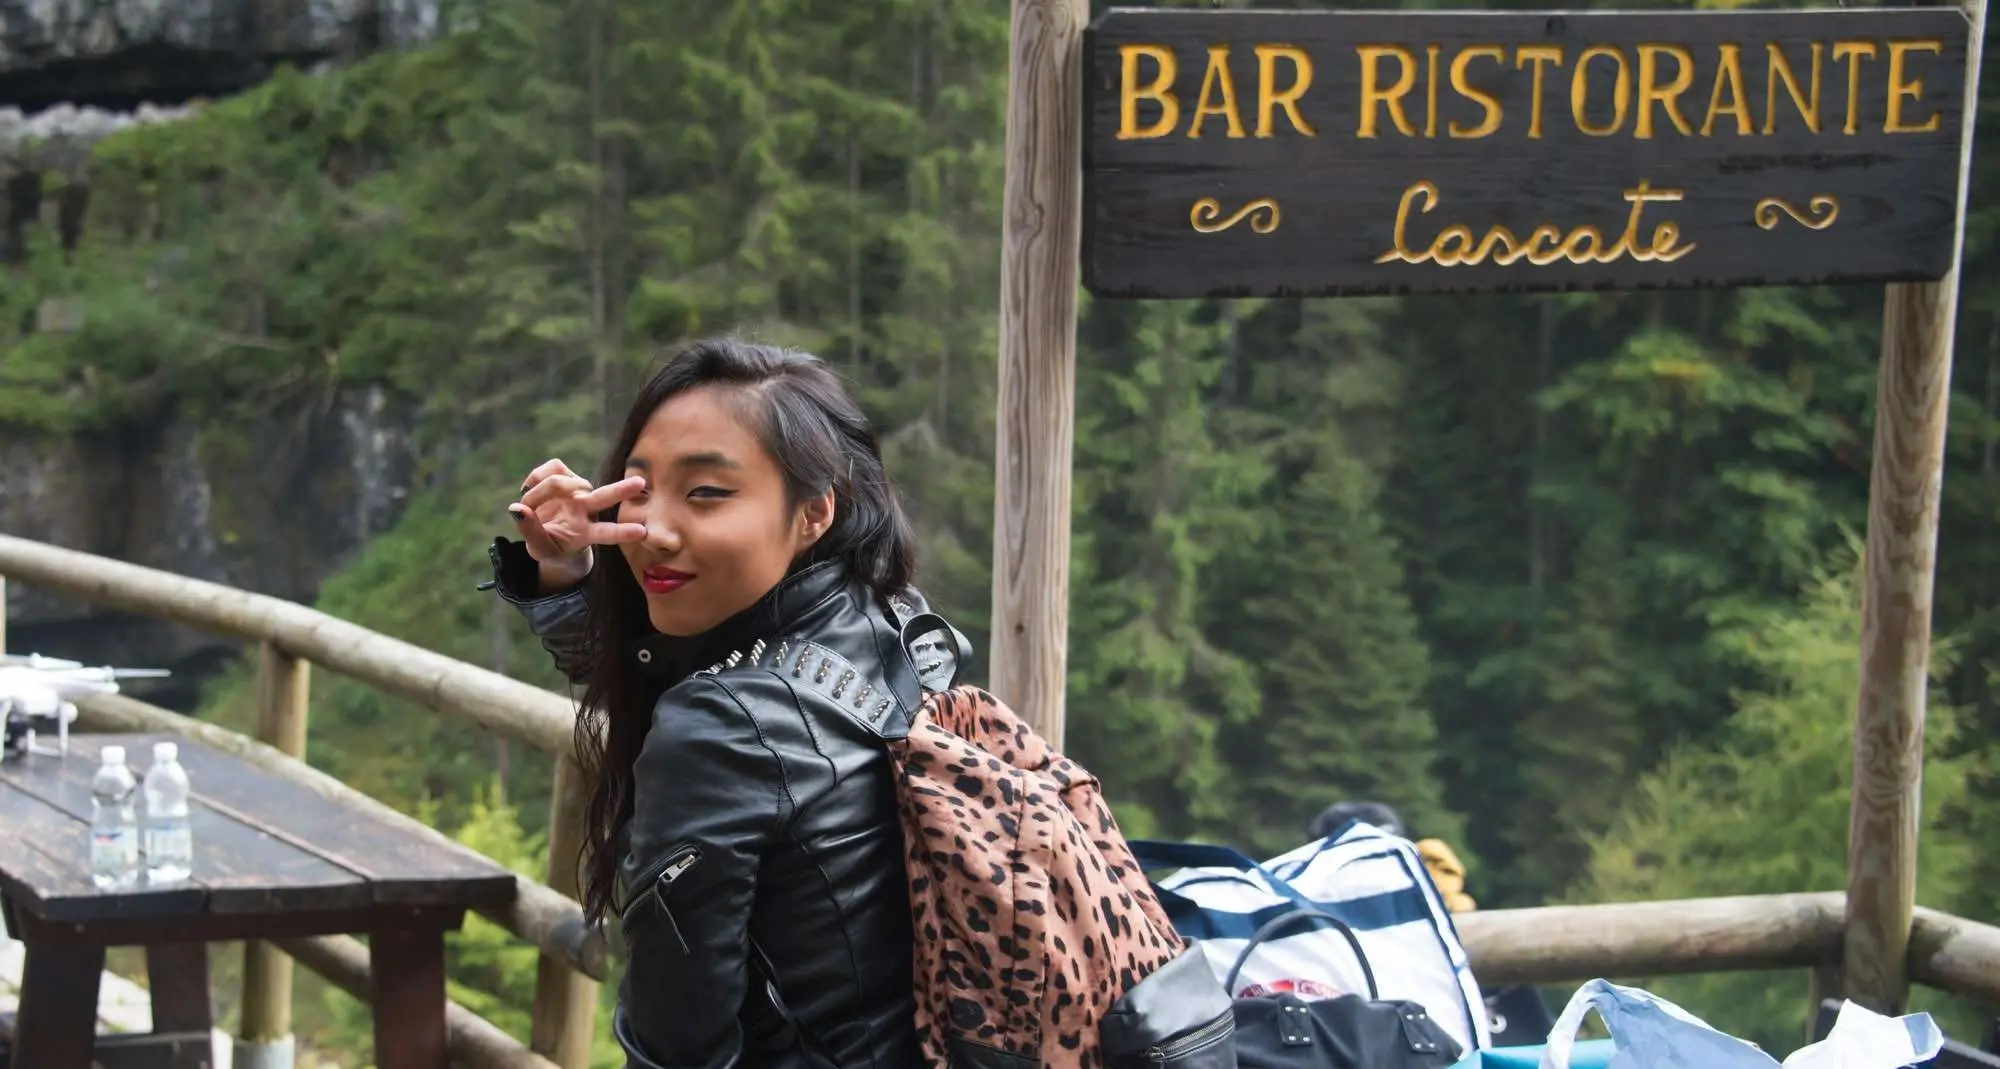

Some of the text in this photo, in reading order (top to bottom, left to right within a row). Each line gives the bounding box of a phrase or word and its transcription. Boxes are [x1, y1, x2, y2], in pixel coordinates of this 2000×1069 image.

[1116, 40, 1943, 140] BAR RISTORANTE
[1375, 179, 1697, 268] Cascate
